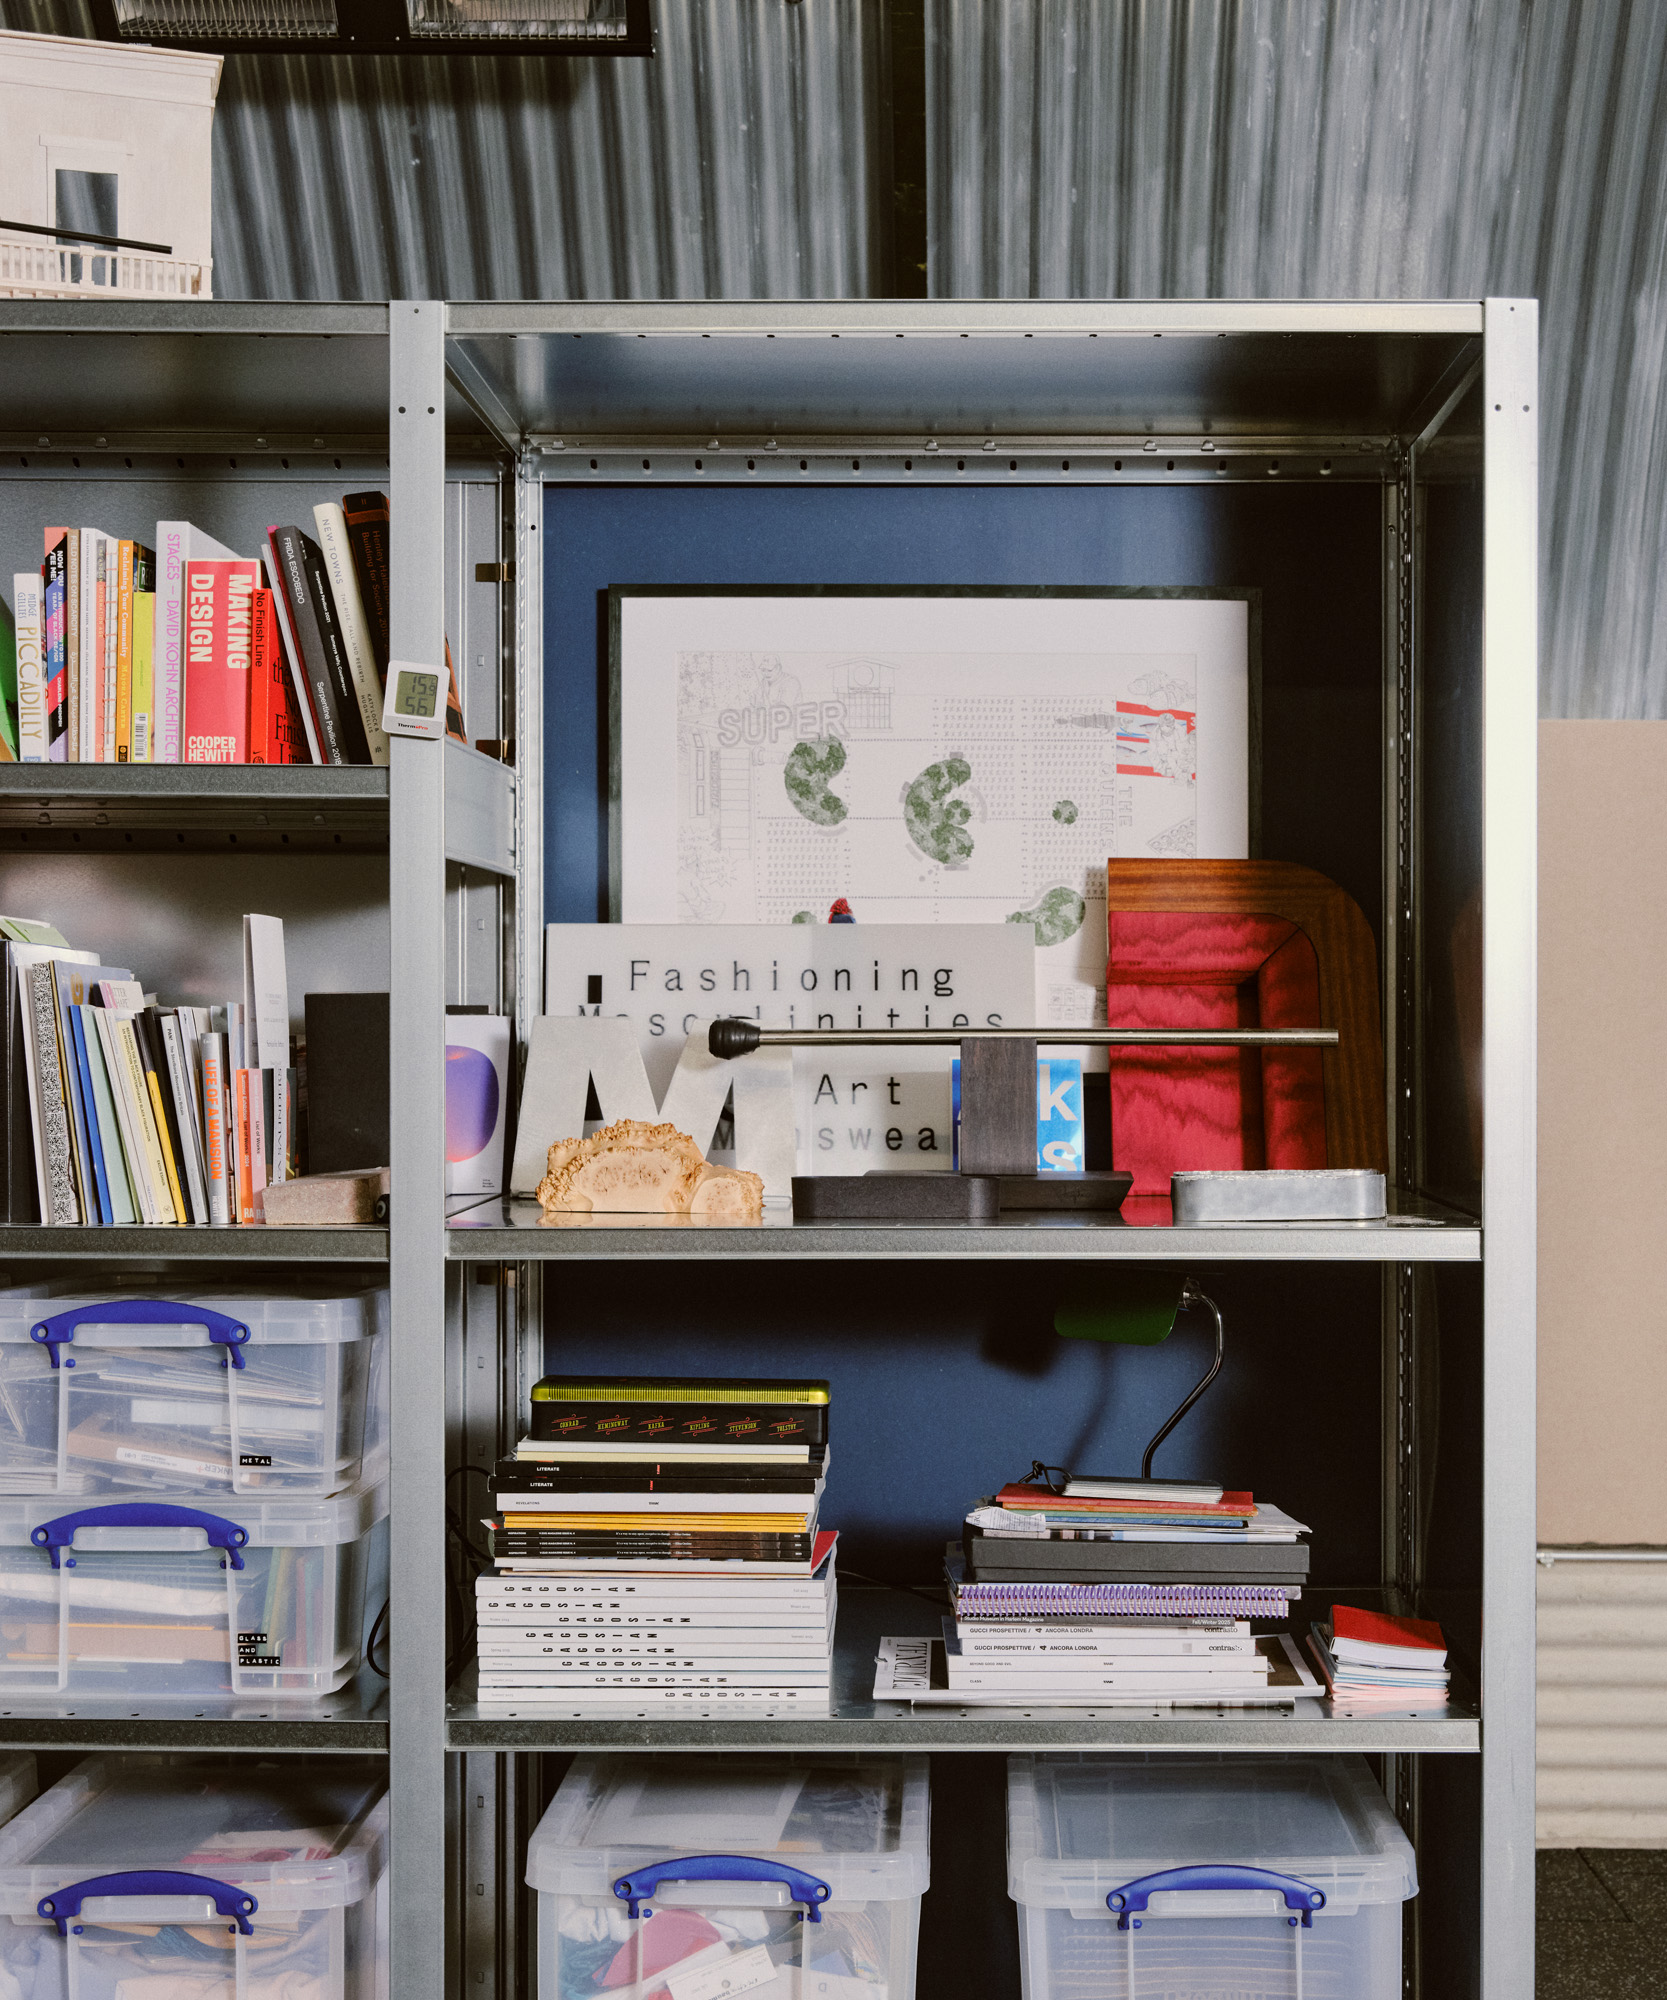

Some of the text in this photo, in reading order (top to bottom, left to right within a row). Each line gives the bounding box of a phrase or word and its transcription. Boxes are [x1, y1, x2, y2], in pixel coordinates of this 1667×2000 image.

[166, 533, 180, 580] STAGES
[322, 518, 344, 585] NEW TOWNS
[361, 531, 375, 567] Building
[57, 570, 65, 586] YOU
[70, 535, 78, 636] FIELD NOTES ON SCARCITY
[283, 537, 295, 560] FRIDA
[289, 561, 305, 604] ESCOBEDO
[17, 592, 27, 619] GILLIES
[27, 593, 37, 617] MIDGE
[57, 591, 63, 600] AN
[119, 546, 129, 657] Reclaiming Your Community
[166, 600, 180, 637] DAVID
[189, 573, 215, 663] DESIGN
[226, 574, 253, 669] MAKING
[255, 592, 265, 667] No Finish Line
[166, 641, 179, 683] KOHN
[355, 657, 365, 683] REBIRTH
[17, 627, 43, 740] PICCADILLY
[317, 681, 343, 765] Serpentine Pavilion 2018
[405, 696, 428, 716] 56
[716, 699, 851, 747] SUPER
[188, 735, 236, 749] COOPER
[188, 749, 236, 762] HEWITT
[1099, 762, 1115, 849] QUEENS
[1118, 785, 1133, 827] THE
[629, 959, 955, 998] Fashioning
[204, 1059, 216, 1085] LIFE
[814, 1072, 901, 1106] Art
[206, 1088, 218, 1106] OF
[207, 1107, 218, 1116] A
[208, 1119, 221, 1179] MANSION
[244, 1207, 254, 1219] RA
[559, 1420, 579, 1429] CONRAD
[597, 1420, 628, 1430] HEMINGWAY
[647, 1421, 665, 1430] KAFKA
[689, 1422, 710, 1431] KIPLING
[729, 1422, 757, 1432] STEVENSON
